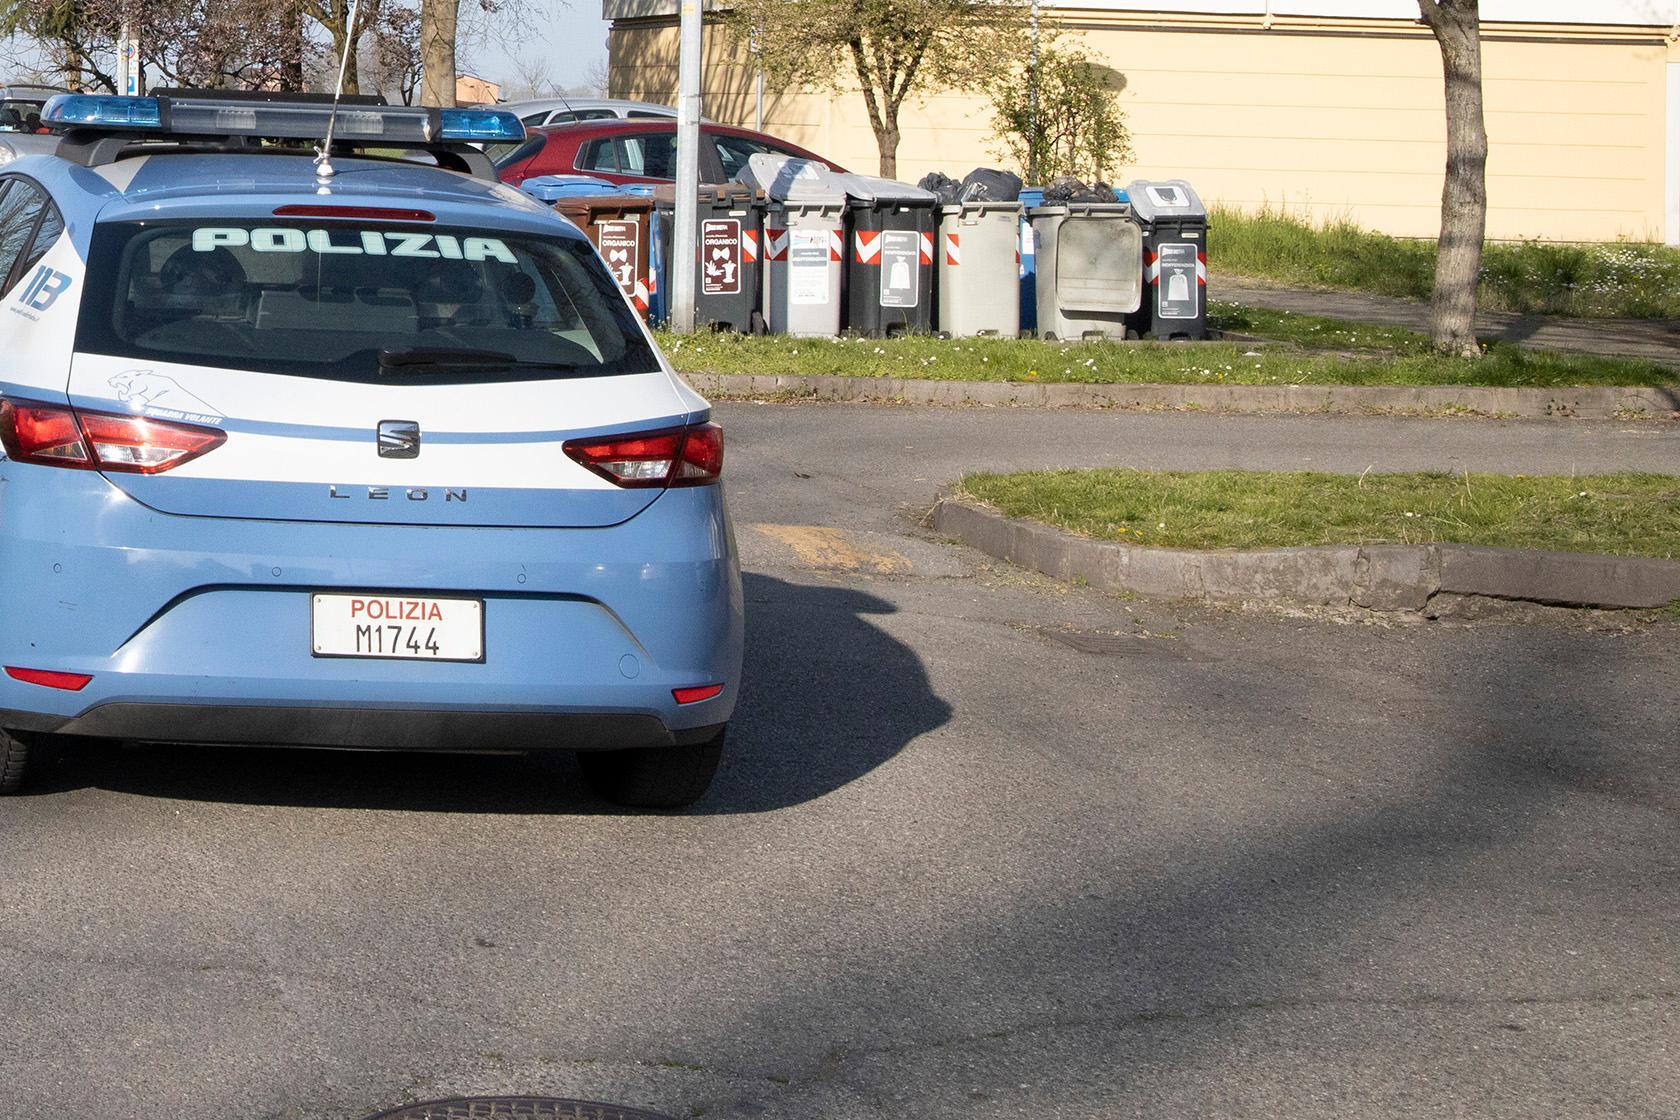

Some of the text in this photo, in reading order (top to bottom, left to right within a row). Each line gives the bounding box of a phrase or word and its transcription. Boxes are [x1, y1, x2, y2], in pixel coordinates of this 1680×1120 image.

[192, 227, 519, 264] POLIZIA
[329, 484, 468, 503] LEON
[351, 599, 443, 621] POLIZIA
[356, 624, 440, 656] M1744
